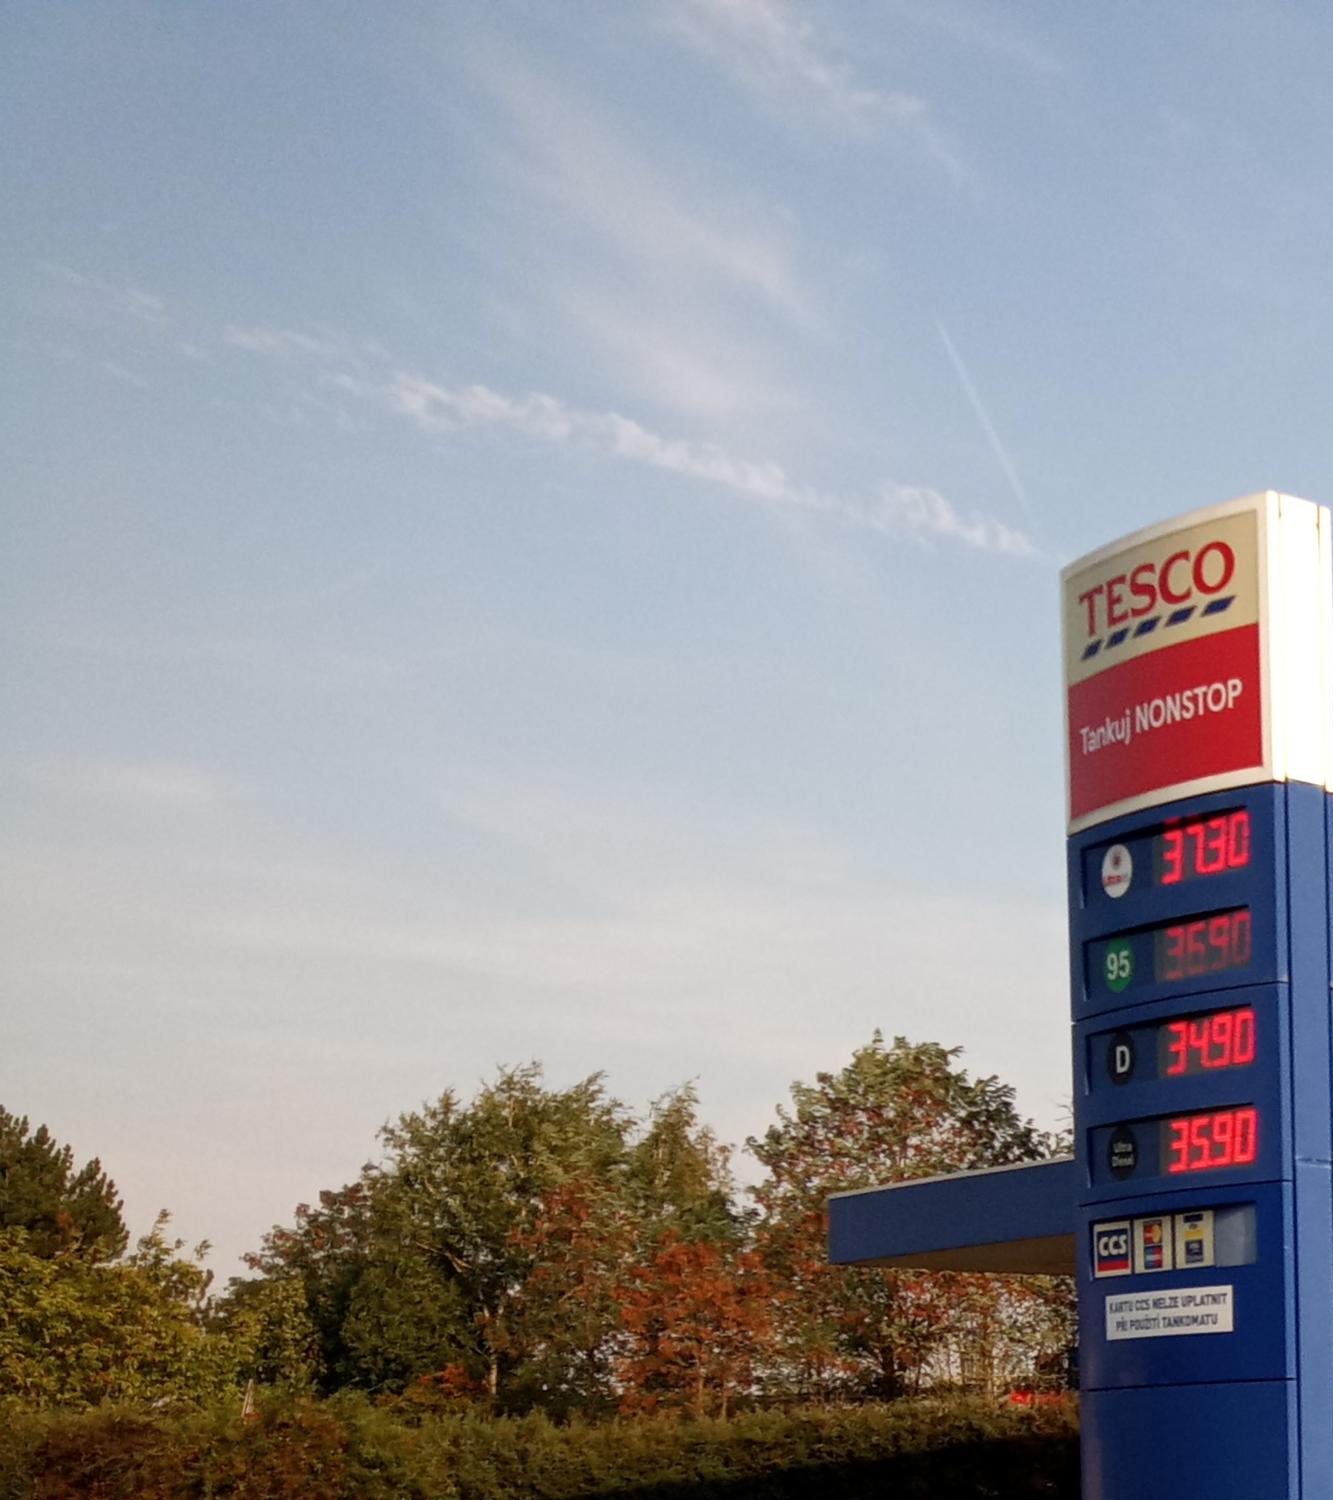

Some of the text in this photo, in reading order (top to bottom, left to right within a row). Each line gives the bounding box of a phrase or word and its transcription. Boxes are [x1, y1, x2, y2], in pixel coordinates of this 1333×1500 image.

[1079, 541, 1236, 636] TESCO
[1080, 679, 1243, 755] Tankuj NONSTOP
[1106, 950, 1130, 981] 95
[1116, 1045, 1131, 1074] D
[1099, 1234, 1127, 1257] CCS
